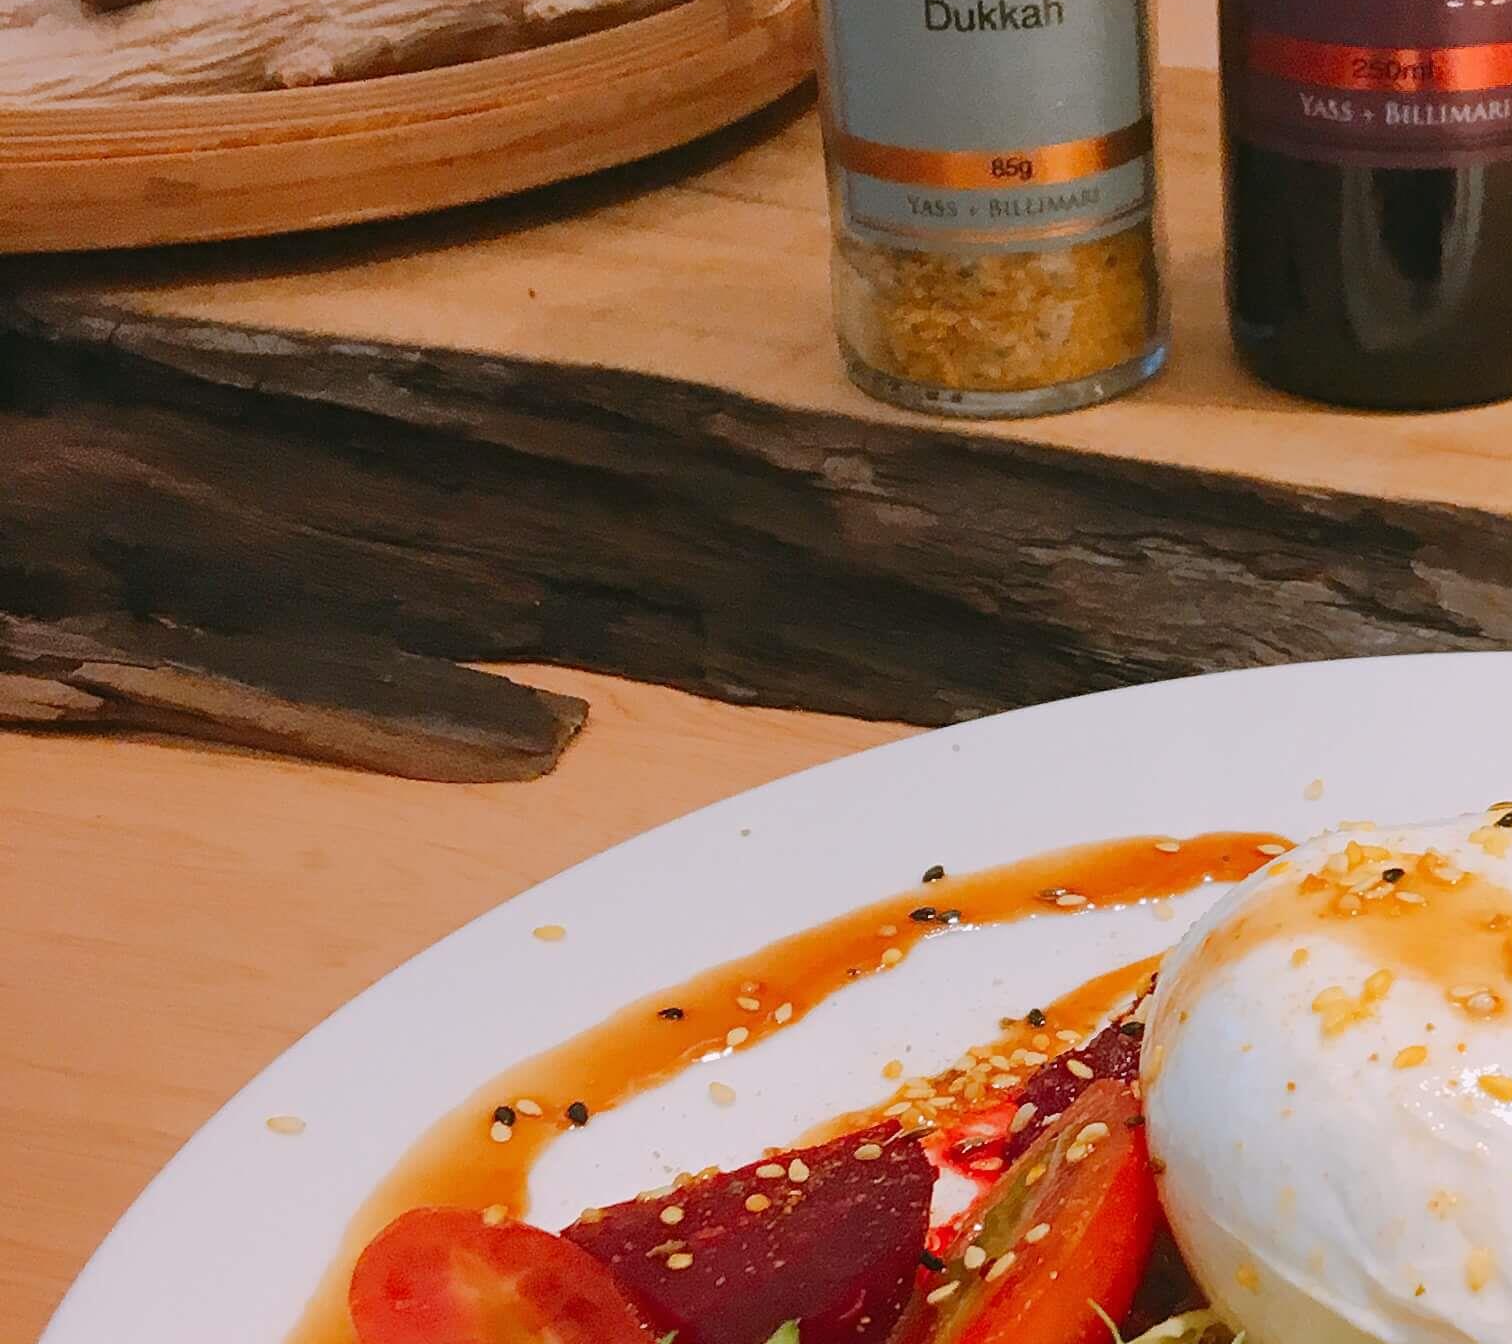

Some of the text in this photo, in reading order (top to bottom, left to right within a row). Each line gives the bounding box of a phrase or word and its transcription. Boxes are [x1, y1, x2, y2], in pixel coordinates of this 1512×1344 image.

[1351, 58, 1436, 80] 250ml
[1301, 93, 1353, 123] YASS
[907, 193, 959, 218] YASS
